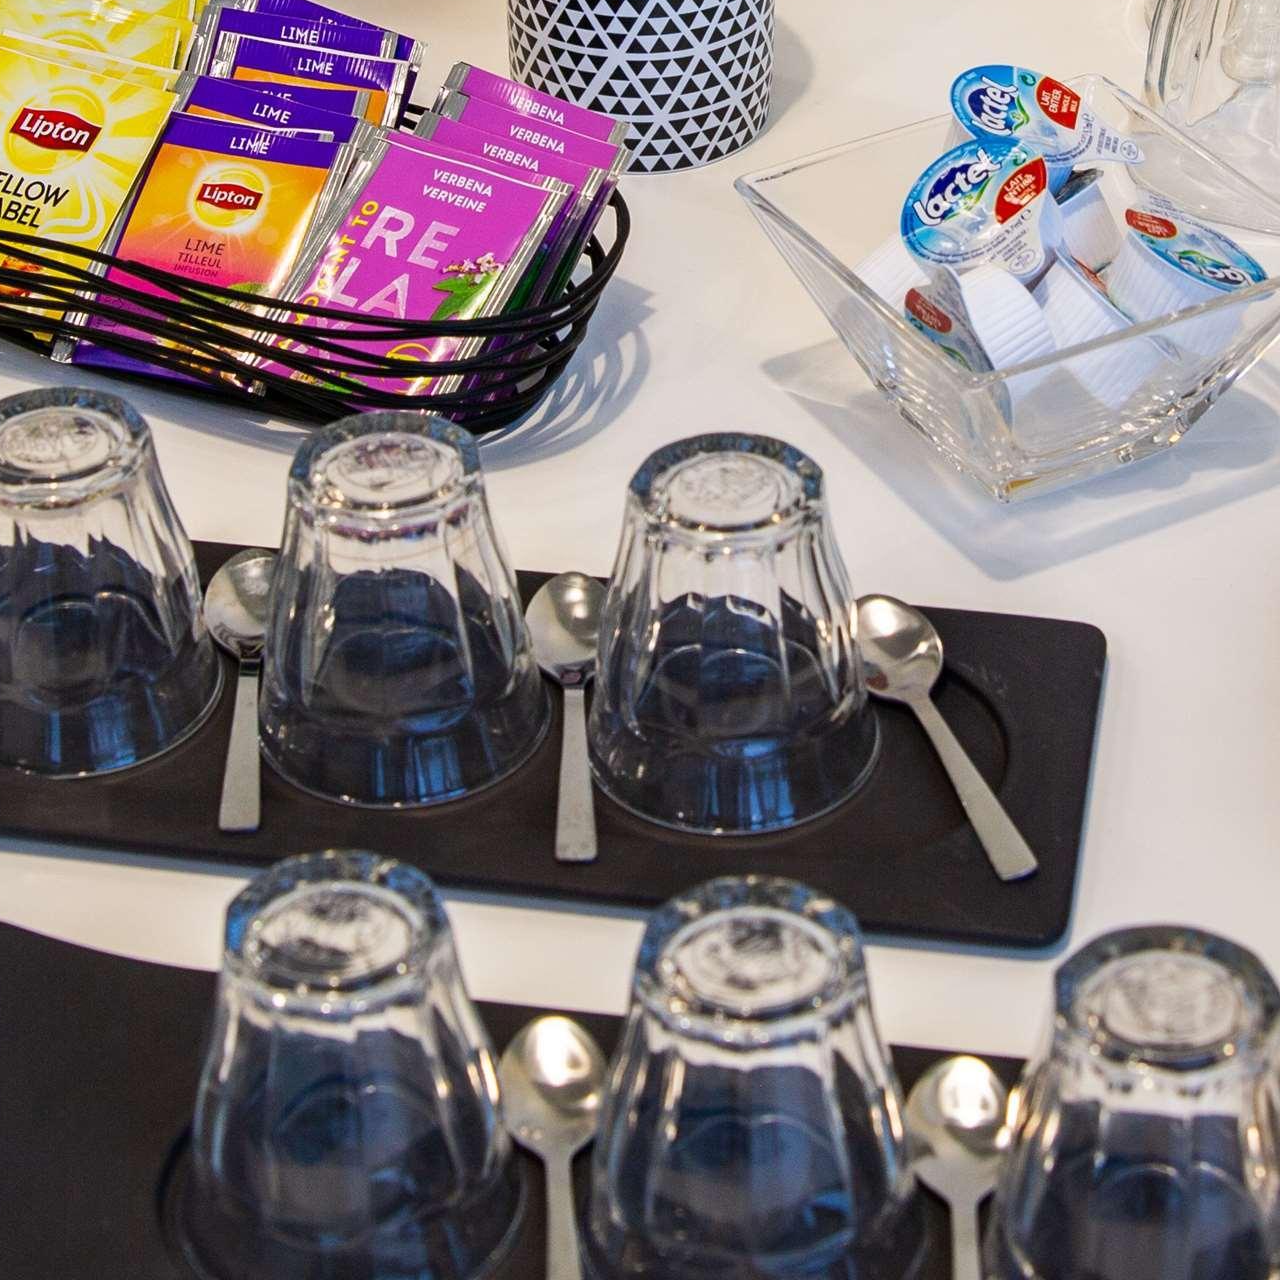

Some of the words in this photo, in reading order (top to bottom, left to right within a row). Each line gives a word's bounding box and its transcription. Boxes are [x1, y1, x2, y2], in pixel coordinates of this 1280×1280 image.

[280, 25, 320, 45] LIME
[297, 57, 334, 76] LIME
[252, 102, 292, 125] LIME
[509, 93, 566, 126] VERBENA
[971, 76, 1018, 136] lactel
[20, 112, 90, 146] Lipton
[509, 124, 566, 154] VERBENA
[230, 136, 270, 155] LIME
[482, 142, 540, 172] VERBENA
[203, 186, 256, 207] Lipton
[433, 169, 493, 198] VERBENA
[912, 147, 1003, 227] lactel
[422, 184, 487, 213] VERVEINE
[351, 200, 380, 232] TO
[185, 238, 226, 256] LIME
[360, 204, 461, 270] RE
[173, 263, 219, 278] INFUSION
[177, 251, 222, 269] TILLEUL
[328, 256, 411, 321] LA
